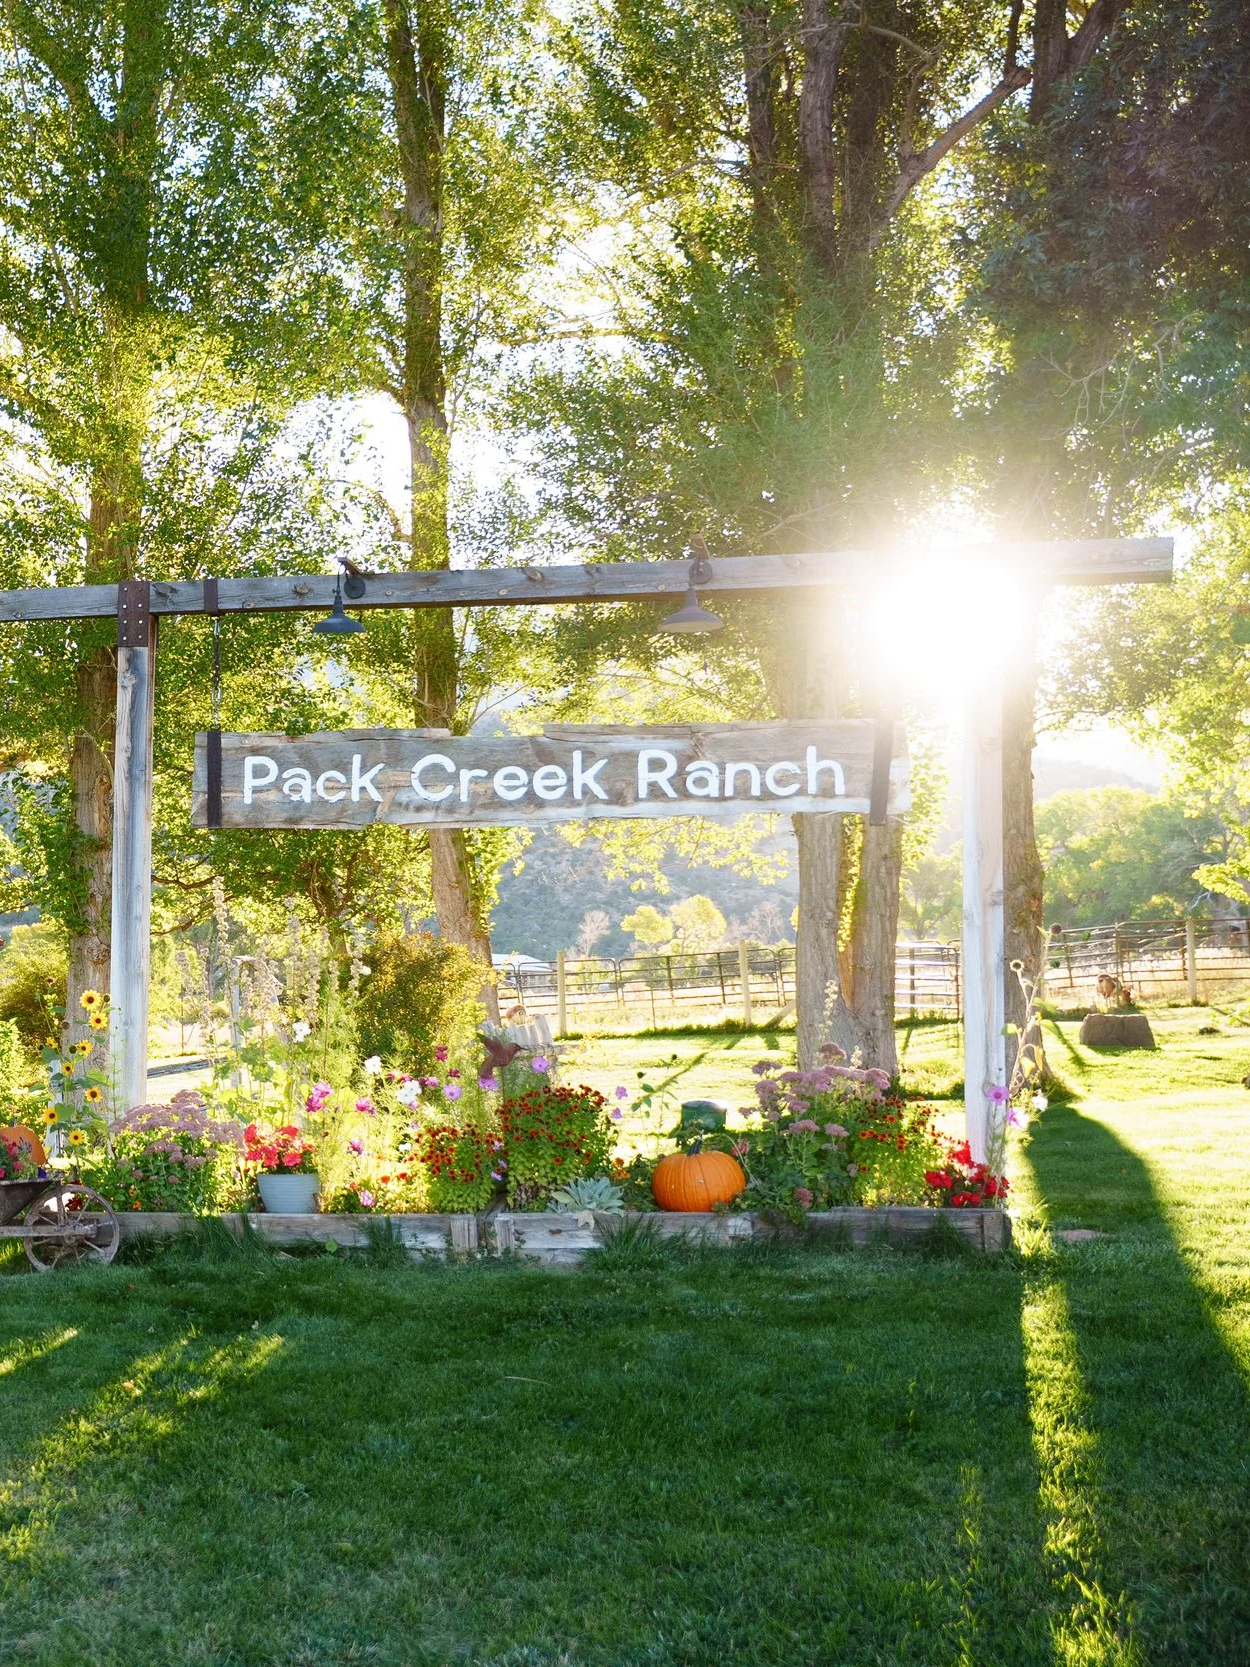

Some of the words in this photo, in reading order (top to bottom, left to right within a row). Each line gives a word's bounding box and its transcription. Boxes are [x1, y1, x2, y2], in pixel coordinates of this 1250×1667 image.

[242, 754, 385, 804] Pack
[410, 750, 609, 801] Creek
[637, 745, 847, 798] Ranch
